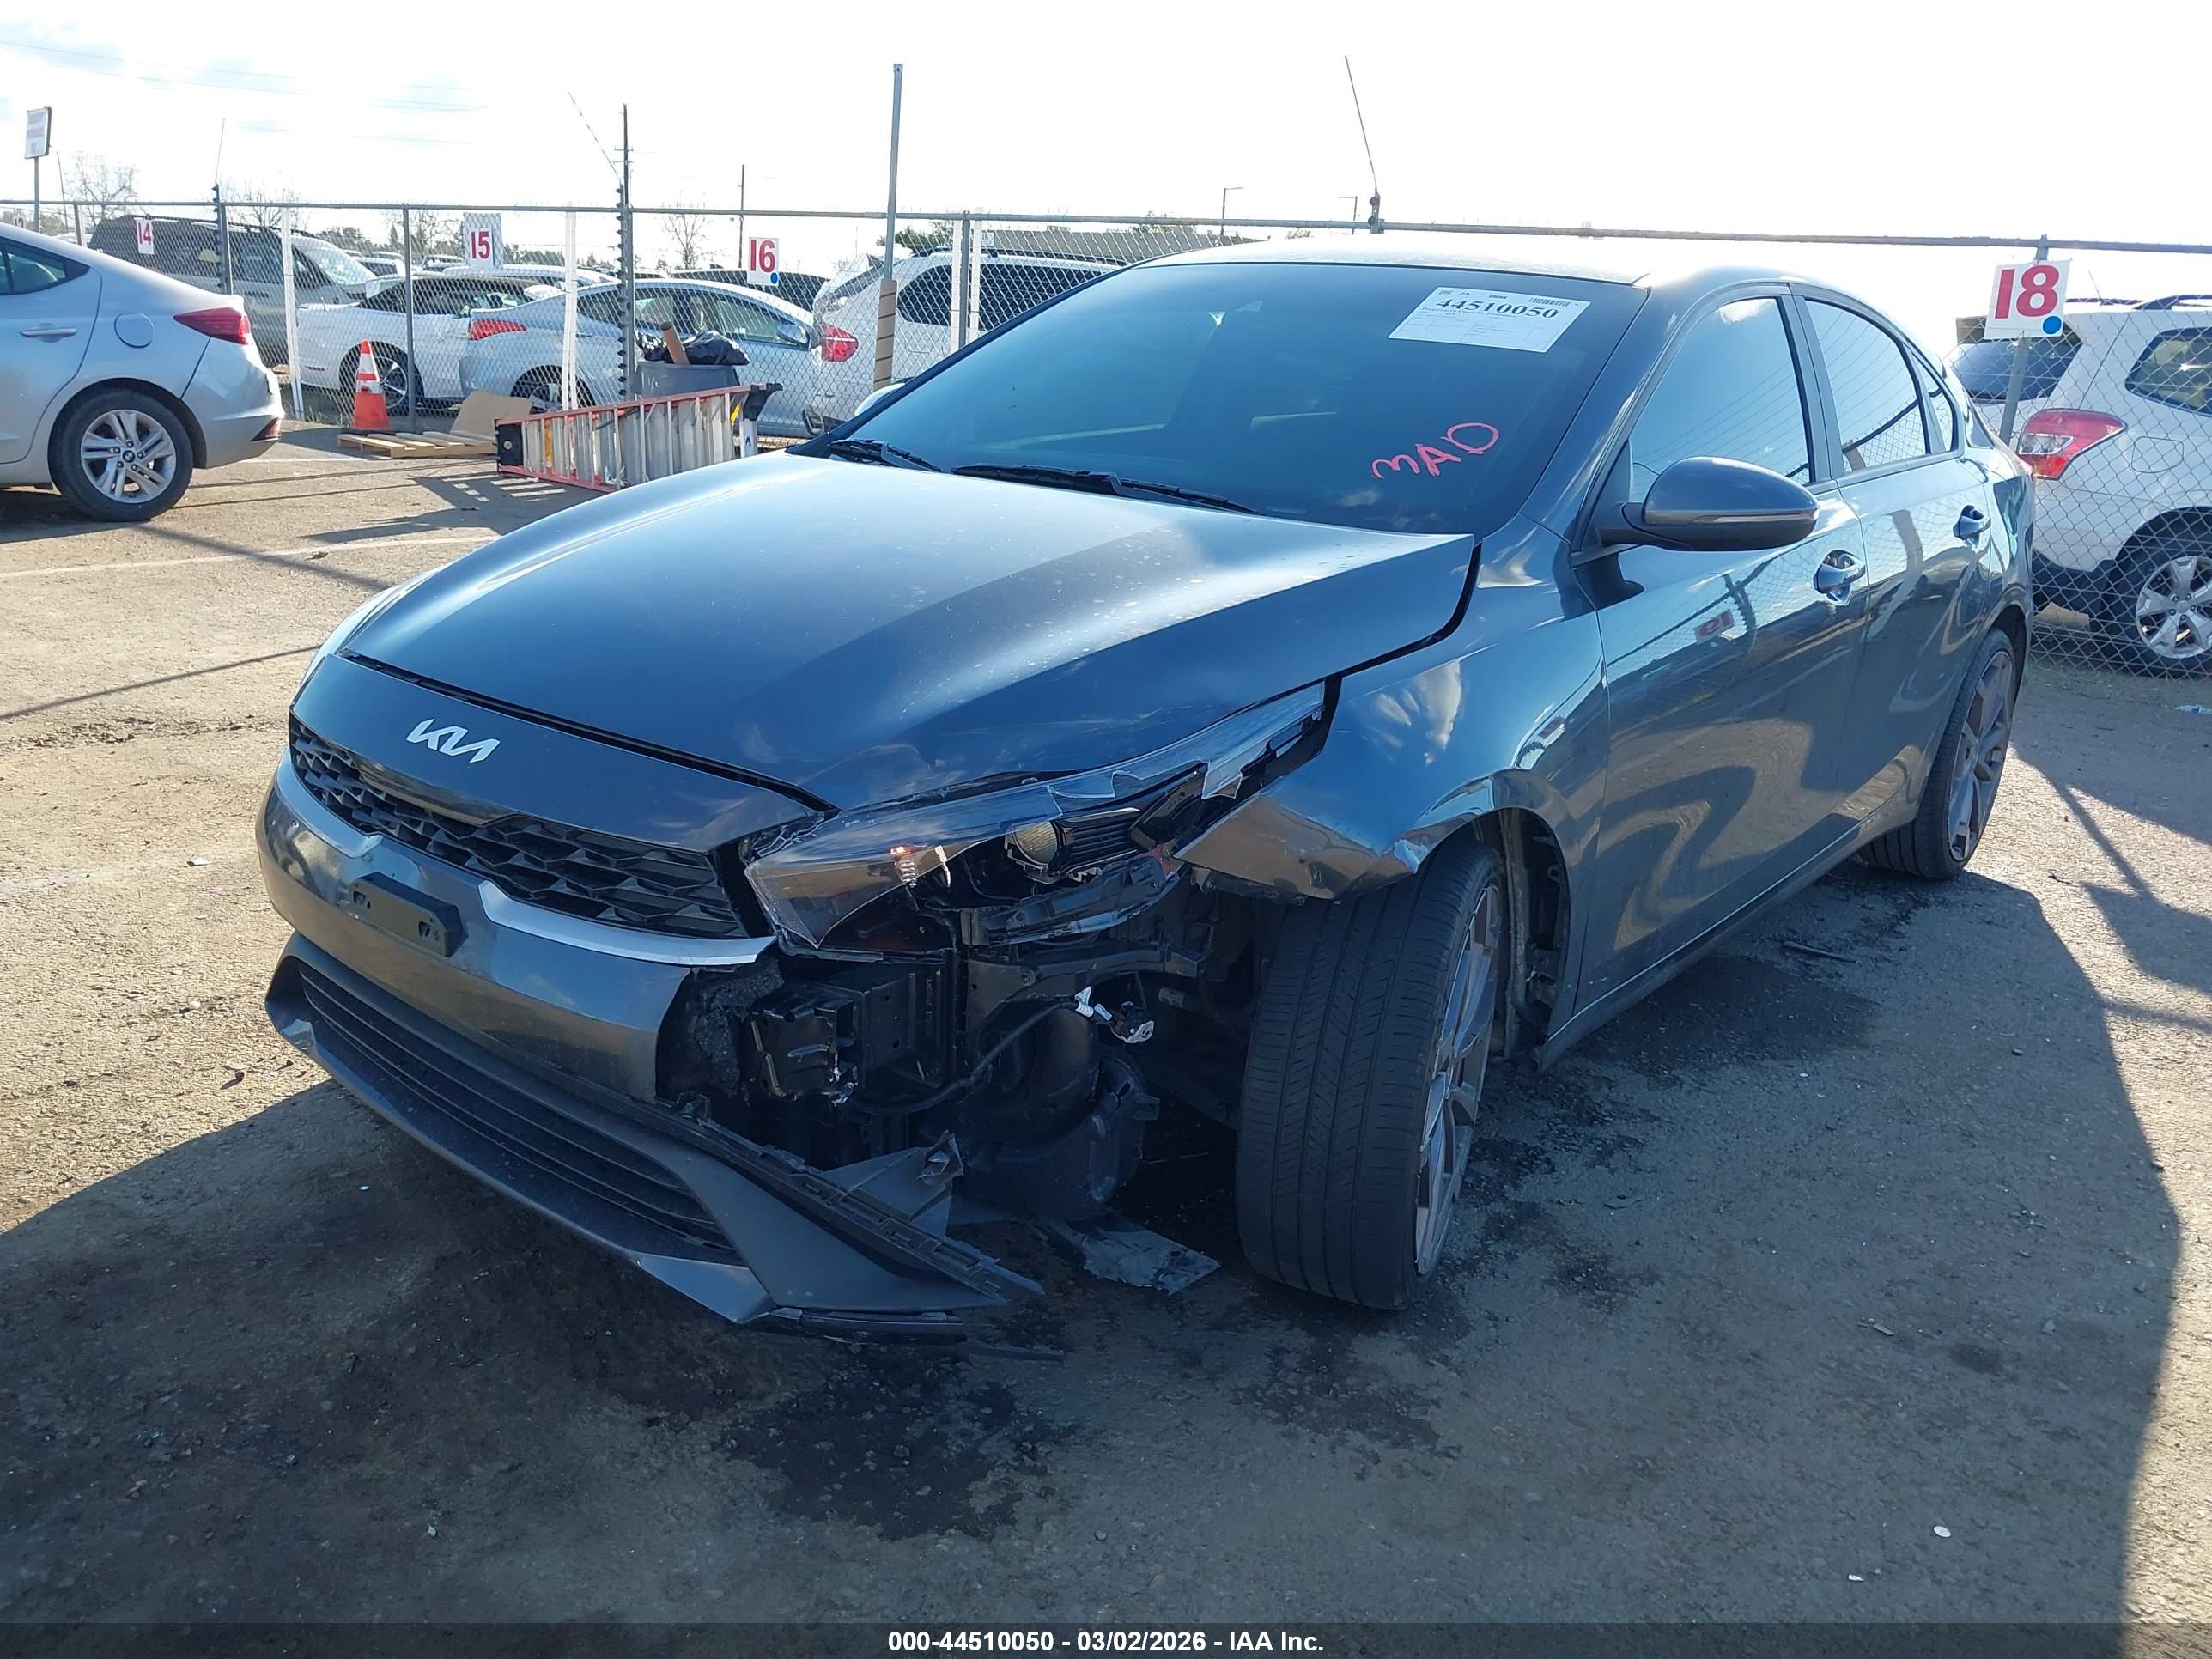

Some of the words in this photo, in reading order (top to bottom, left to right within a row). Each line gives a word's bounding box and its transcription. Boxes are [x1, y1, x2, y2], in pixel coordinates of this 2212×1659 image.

[138, 222, 151, 245] 14
[471, 231, 490, 259] 15
[750, 240, 775, 272] 16
[1995, 264, 2059, 319] 18
[1436, 299, 1559, 319] 44510050
[406, 718, 501, 763] KIA
